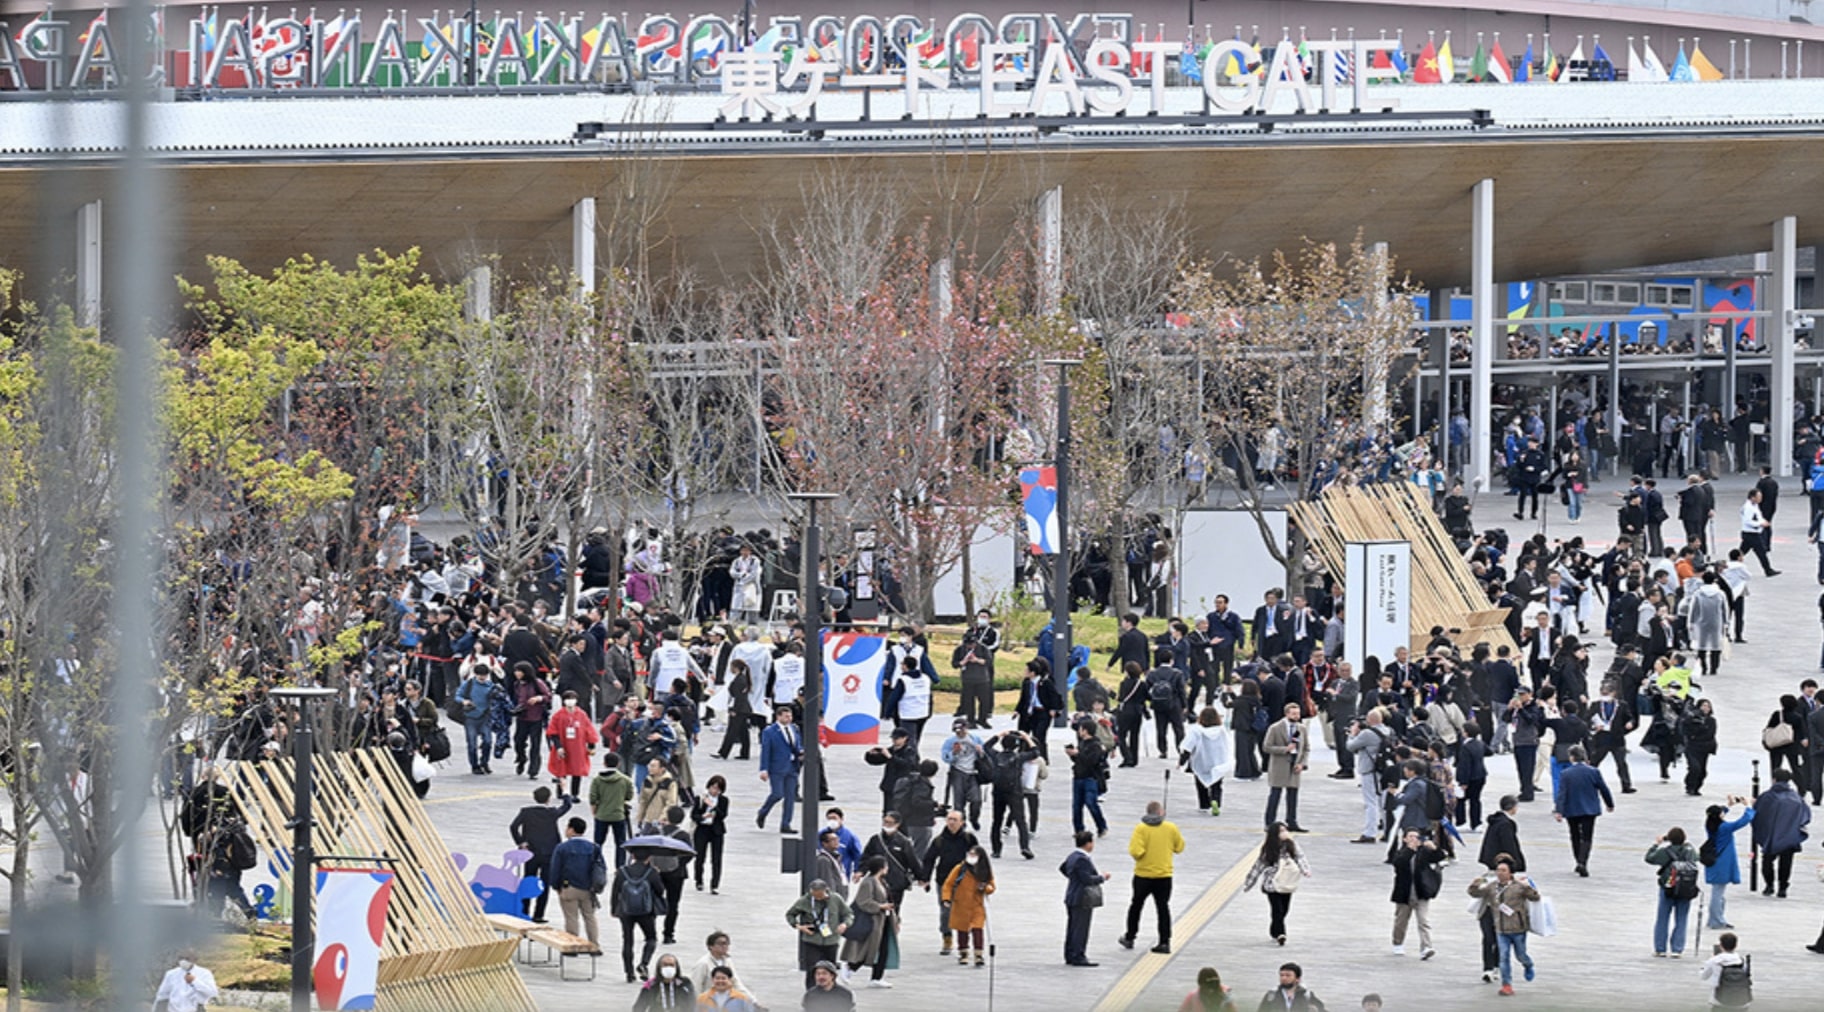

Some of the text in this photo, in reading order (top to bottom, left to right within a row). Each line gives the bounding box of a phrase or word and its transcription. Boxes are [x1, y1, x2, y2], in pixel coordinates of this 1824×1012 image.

[719, 39, 1401, 116] 東ゲート EAST GATE
